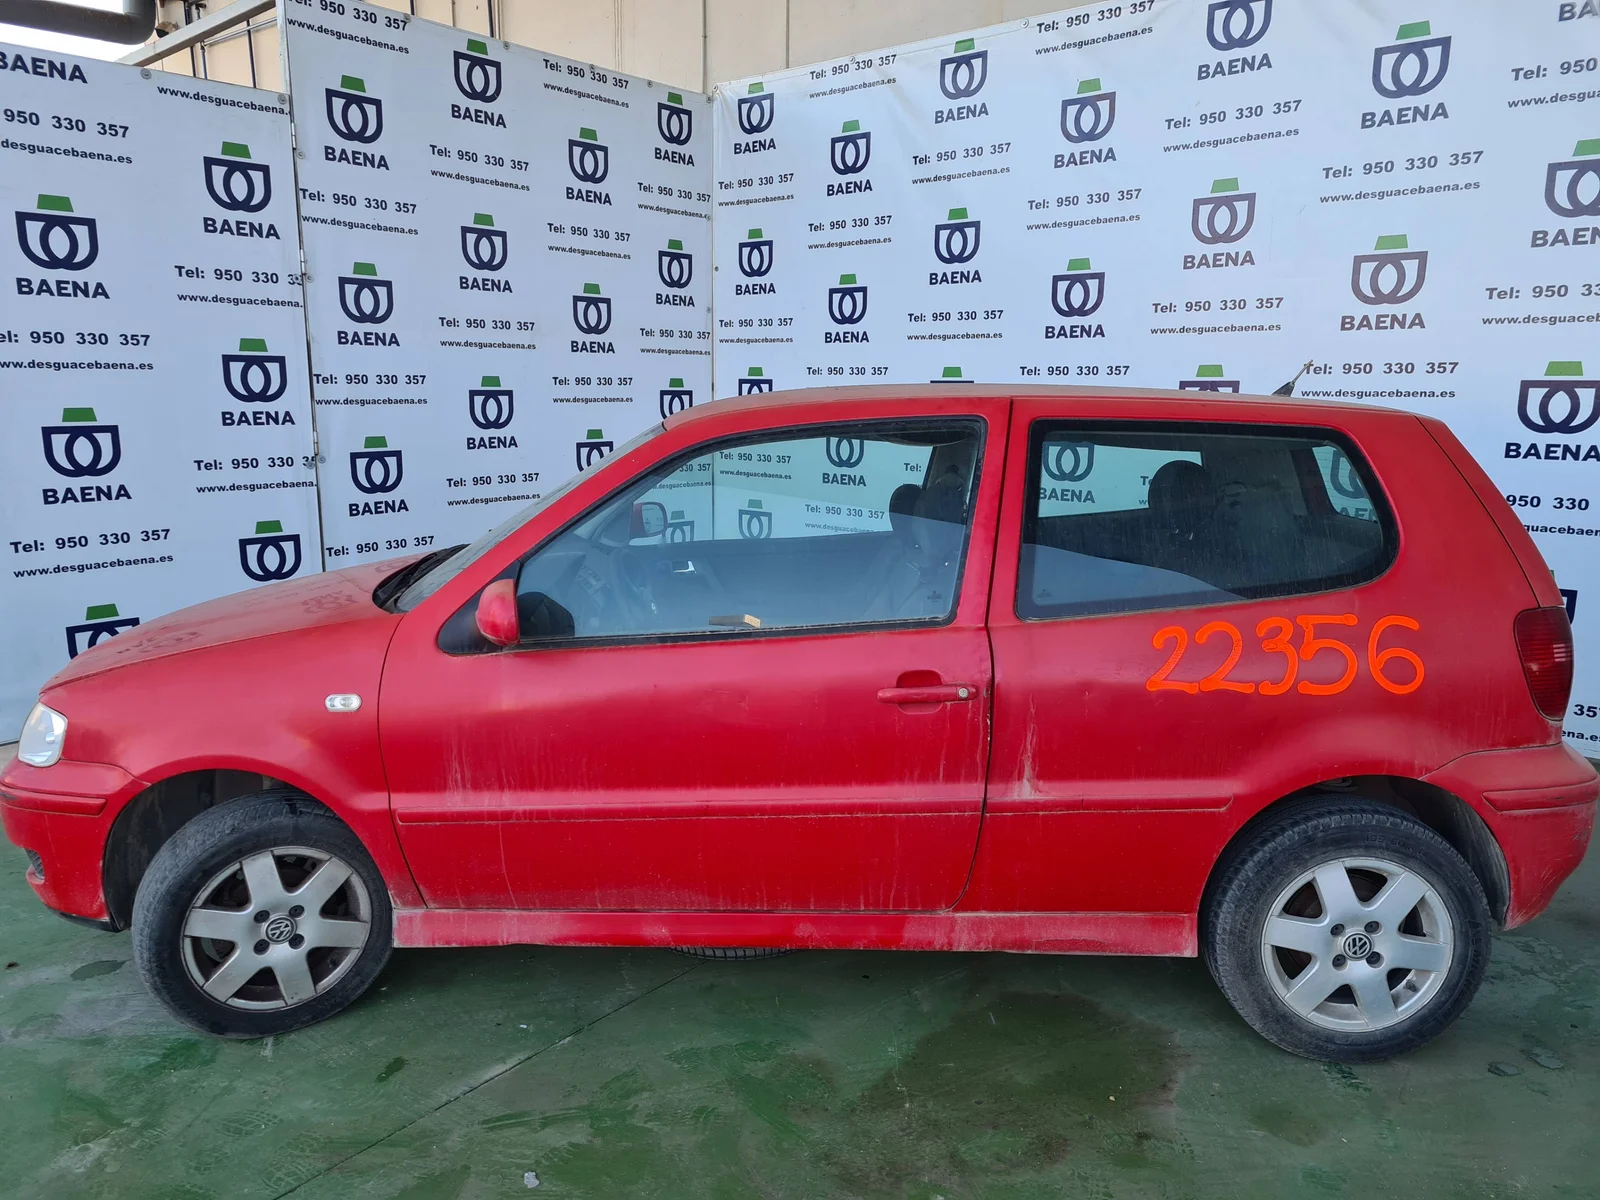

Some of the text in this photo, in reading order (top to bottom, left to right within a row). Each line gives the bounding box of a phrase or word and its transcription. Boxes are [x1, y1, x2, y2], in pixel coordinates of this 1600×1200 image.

[353, 8, 407, 31] 330 357
[1036, 0, 1155, 33] Tel: 950 330 357
[287, 18, 410, 54] www.desguacebaena.es
[542, 58, 629, 89] Tel: 950 330 357
[1197, 53, 1272, 81] BAENA
[1511, 58, 1597, 81] Tel: 950
[451, 103, 507, 129] BAENA
[935, 102, 989, 124] BAENA
[1165, 99, 1302, 130] Tel: 950 330 357
[1361, 102, 1449, 129] BAENA
[3, 108, 129, 138] 950 330 357
[734, 138, 776, 155] BAENA
[1163, 129, 1299, 152] www.desguacebaena.es
[324, 145, 390, 171] BAENA
[429, 144, 529, 171] Tel: 950 330 357
[654, 147, 695, 167] BAENA
[912, 142, 1011, 165] Tel: 950 330 357
[1054, 147, 1117, 169] BAENA
[1322, 150, 1484, 179] Tel: 950 330 357
[430, 170, 530, 191] www.desguacebaena.es
[912, 167, 1010, 184] www.desguacebaena.es
[566, 186, 612, 206] BAENA
[827, 179, 873, 197] BAENA
[1320, 182, 1480, 203] www.desguacebaena.es
[299, 187, 417, 214] Tel: 950 330 357
[1028, 188, 1142, 210] Tel: 950 330 357
[203, 217, 281, 240] BAENA
[302, 214, 419, 236] www.desguacebaena.es
[808, 215, 892, 232] Tel: 950 330 357
[1026, 215, 1140, 230] www.desguacebaena.es
[547, 222, 631, 242] Tel: 950 330 357
[808, 237, 892, 250] www.desguacebaena.es
[1183, 250, 1255, 270] BAENA
[174, 265, 279, 284] Tel: 950 330
[929, 269, 982, 285] BAENA
[16, 277, 110, 299] BAENA
[459, 276, 513, 293] BAENA
[735, 282, 776, 296] BAENA
[1485, 285, 1568, 300] Tel: 950
[656, 293, 695, 307] BAENA
[1152, 297, 1284, 313] Tel: 950 330 357
[438, 317, 535, 331] Tel: 950 330 357
[907, 310, 1004, 322] Tel: 950 330 357
[1340, 313, 1426, 331] BAENA
[29, 331, 150, 346] 950 330 357
[337, 330, 400, 347] BAENA
[639, 328, 711, 340] Tel: 950 330 357
[824, 331, 870, 344] BAENA
[907, 332, 1003, 341] www.desguacebaena.es
[1045, 324, 1105, 339] BAENA
[1150, 324, 1281, 335] www.desguacebaena.es
[440, 340, 536, 350] www.desguacebaena.es
[571, 340, 615, 354] BAENA
[1019, 365, 1130, 376] Tel: 950 330 357
[1342, 362, 1459, 374] 950 330 357
[313, 374, 426, 385] Tel: 950 330 357
[552, 376, 633, 386] Tel: 950 330 357
[315, 397, 428, 407] www.desguacebaena.es
[1301, 389, 1455, 399] www.desguacebaena.es
[221, 410, 296, 426] BAENA
[466, 436, 518, 450] BAENA
[193, 456, 294, 471] Tel: 950 330
[719, 451, 792, 464] Tel: 950 330 357
[446, 472, 539, 488] Tel: 950 330 357
[822, 473, 866, 486] BAENA
[42, 484, 132, 505] BAENA
[348, 499, 409, 517] BAENA
[1552, 497, 1590, 511] 330
[9, 528, 170, 554] Tel: 950 330 357
[325, 536, 434, 557] Tel: 950 330 357
[13, 555, 174, 578] www.desguacebaena.es
[1146, 614, 1425, 695] 22356
